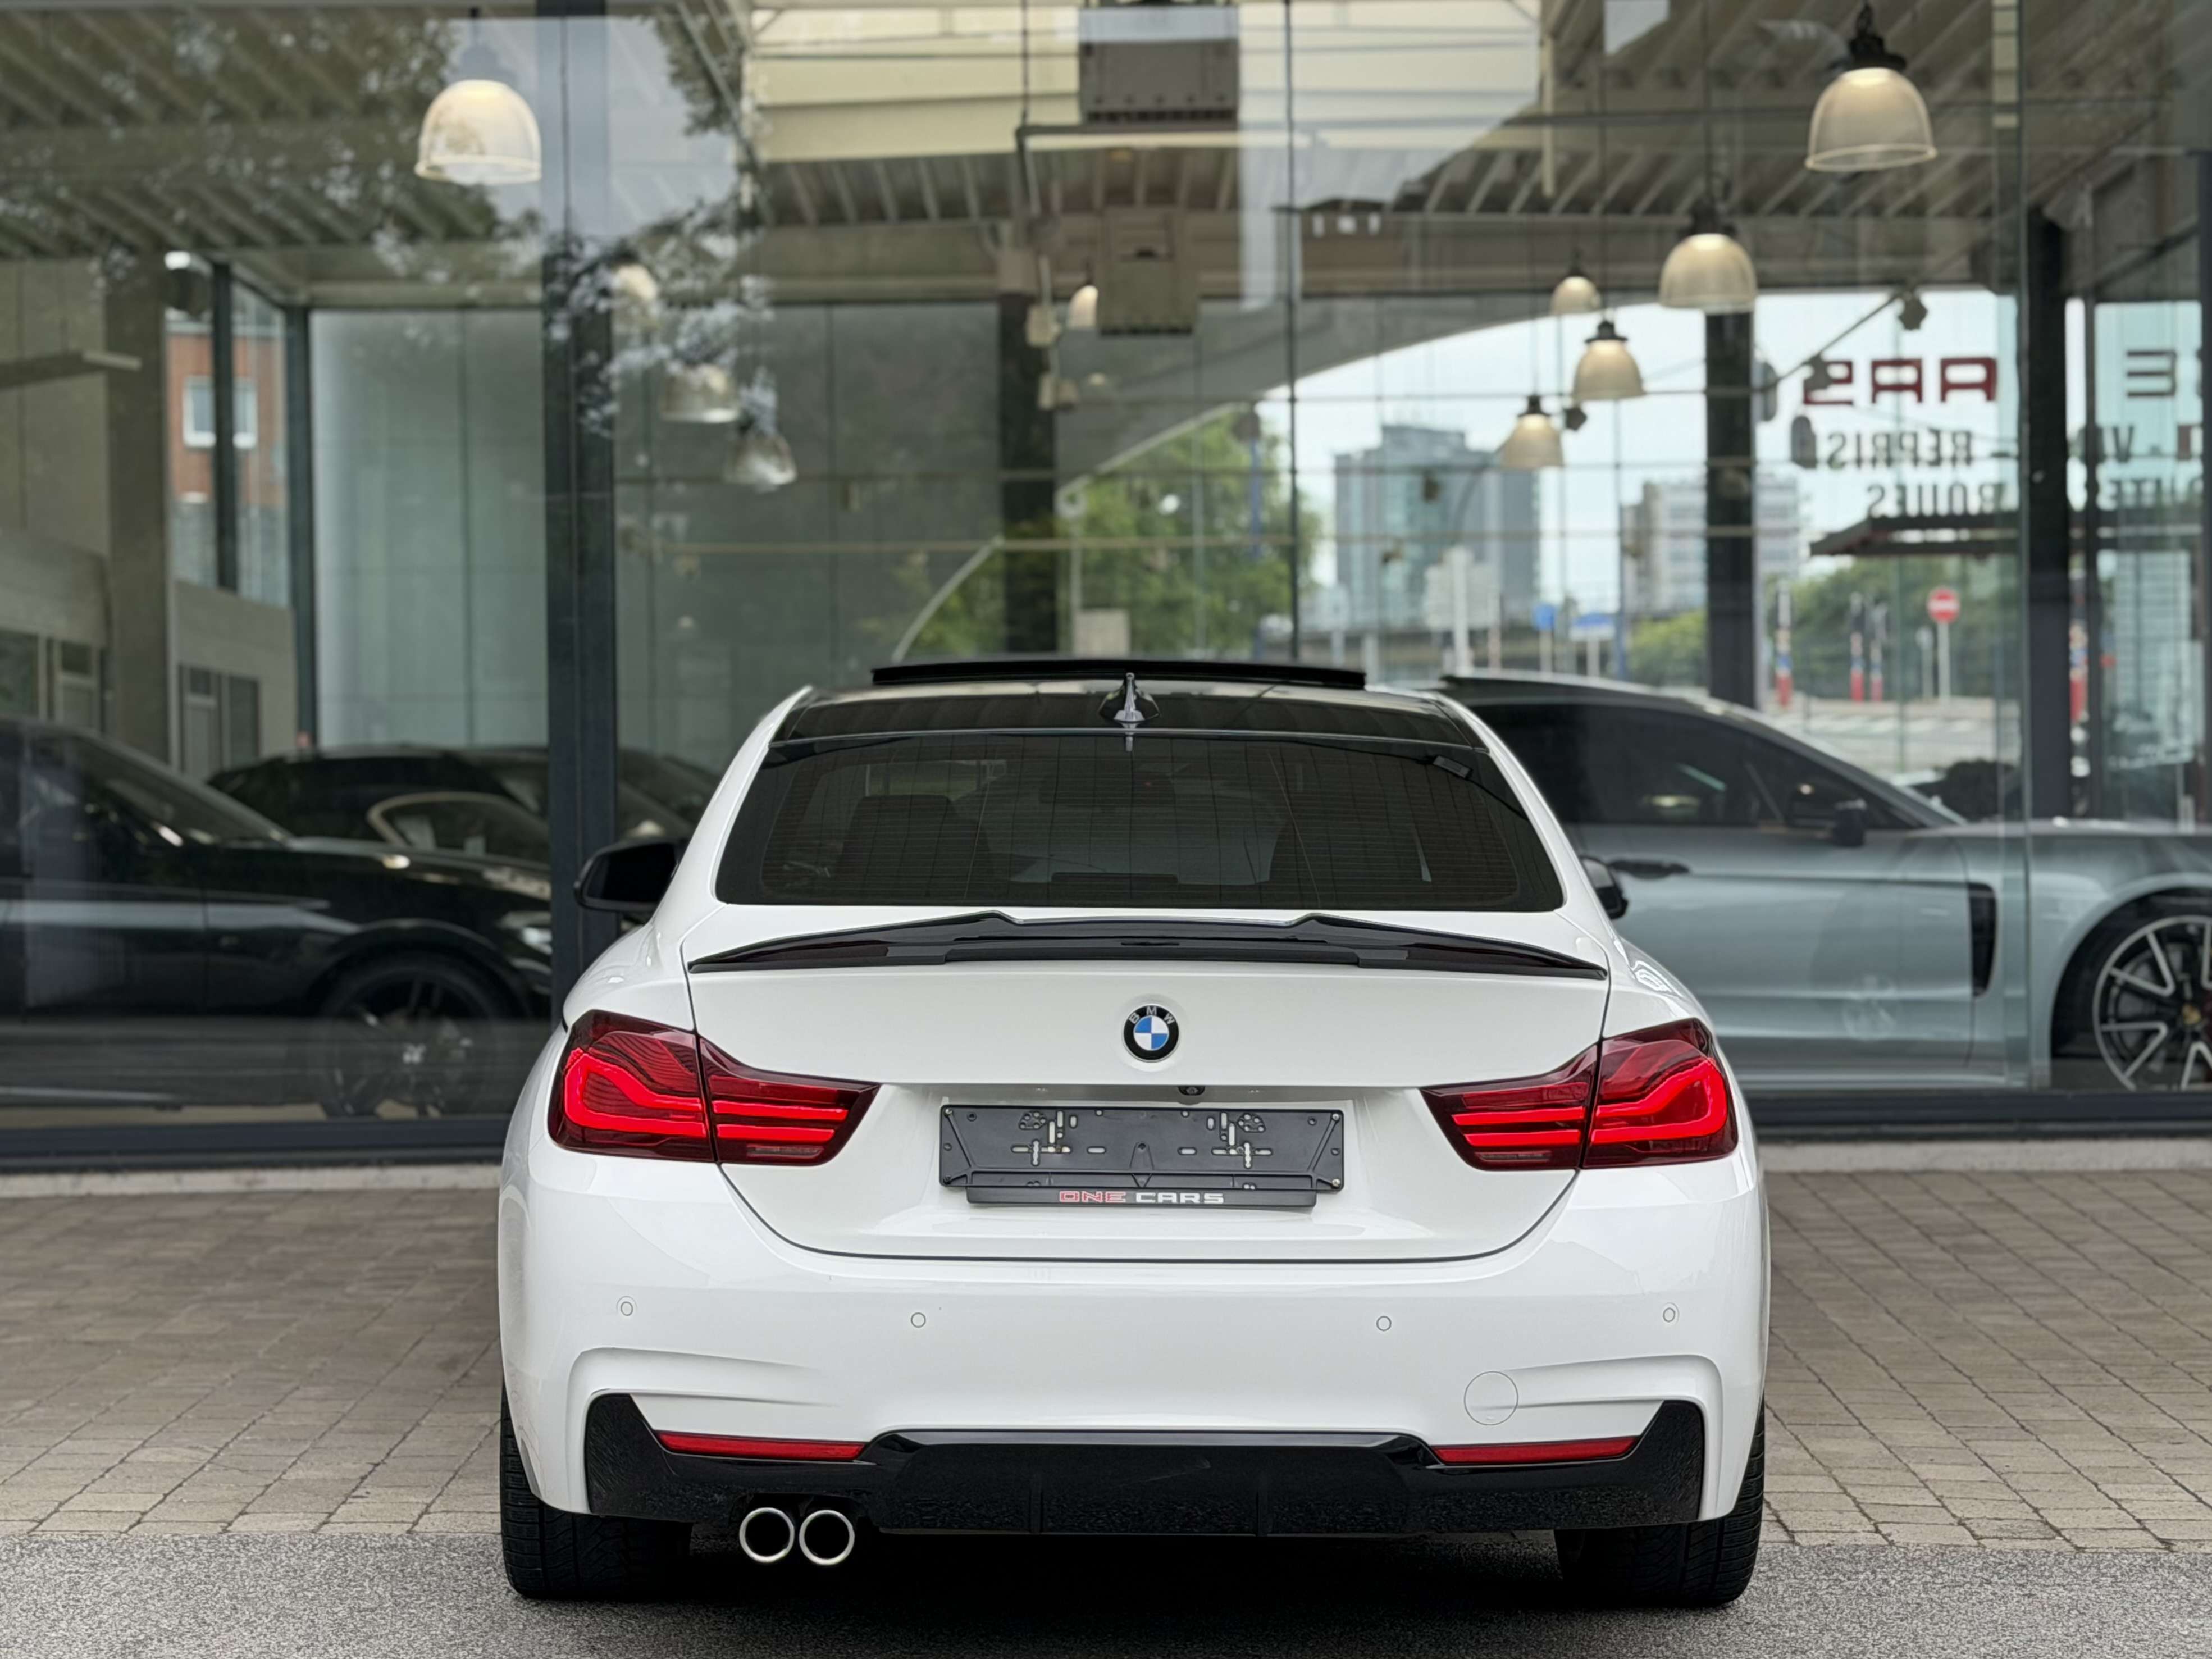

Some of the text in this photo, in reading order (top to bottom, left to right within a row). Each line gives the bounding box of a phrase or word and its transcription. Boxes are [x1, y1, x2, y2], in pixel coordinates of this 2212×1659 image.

[1128, 1006, 1175, 1025] BMW
[1059, 1191, 1224, 1204] ONE CARS
